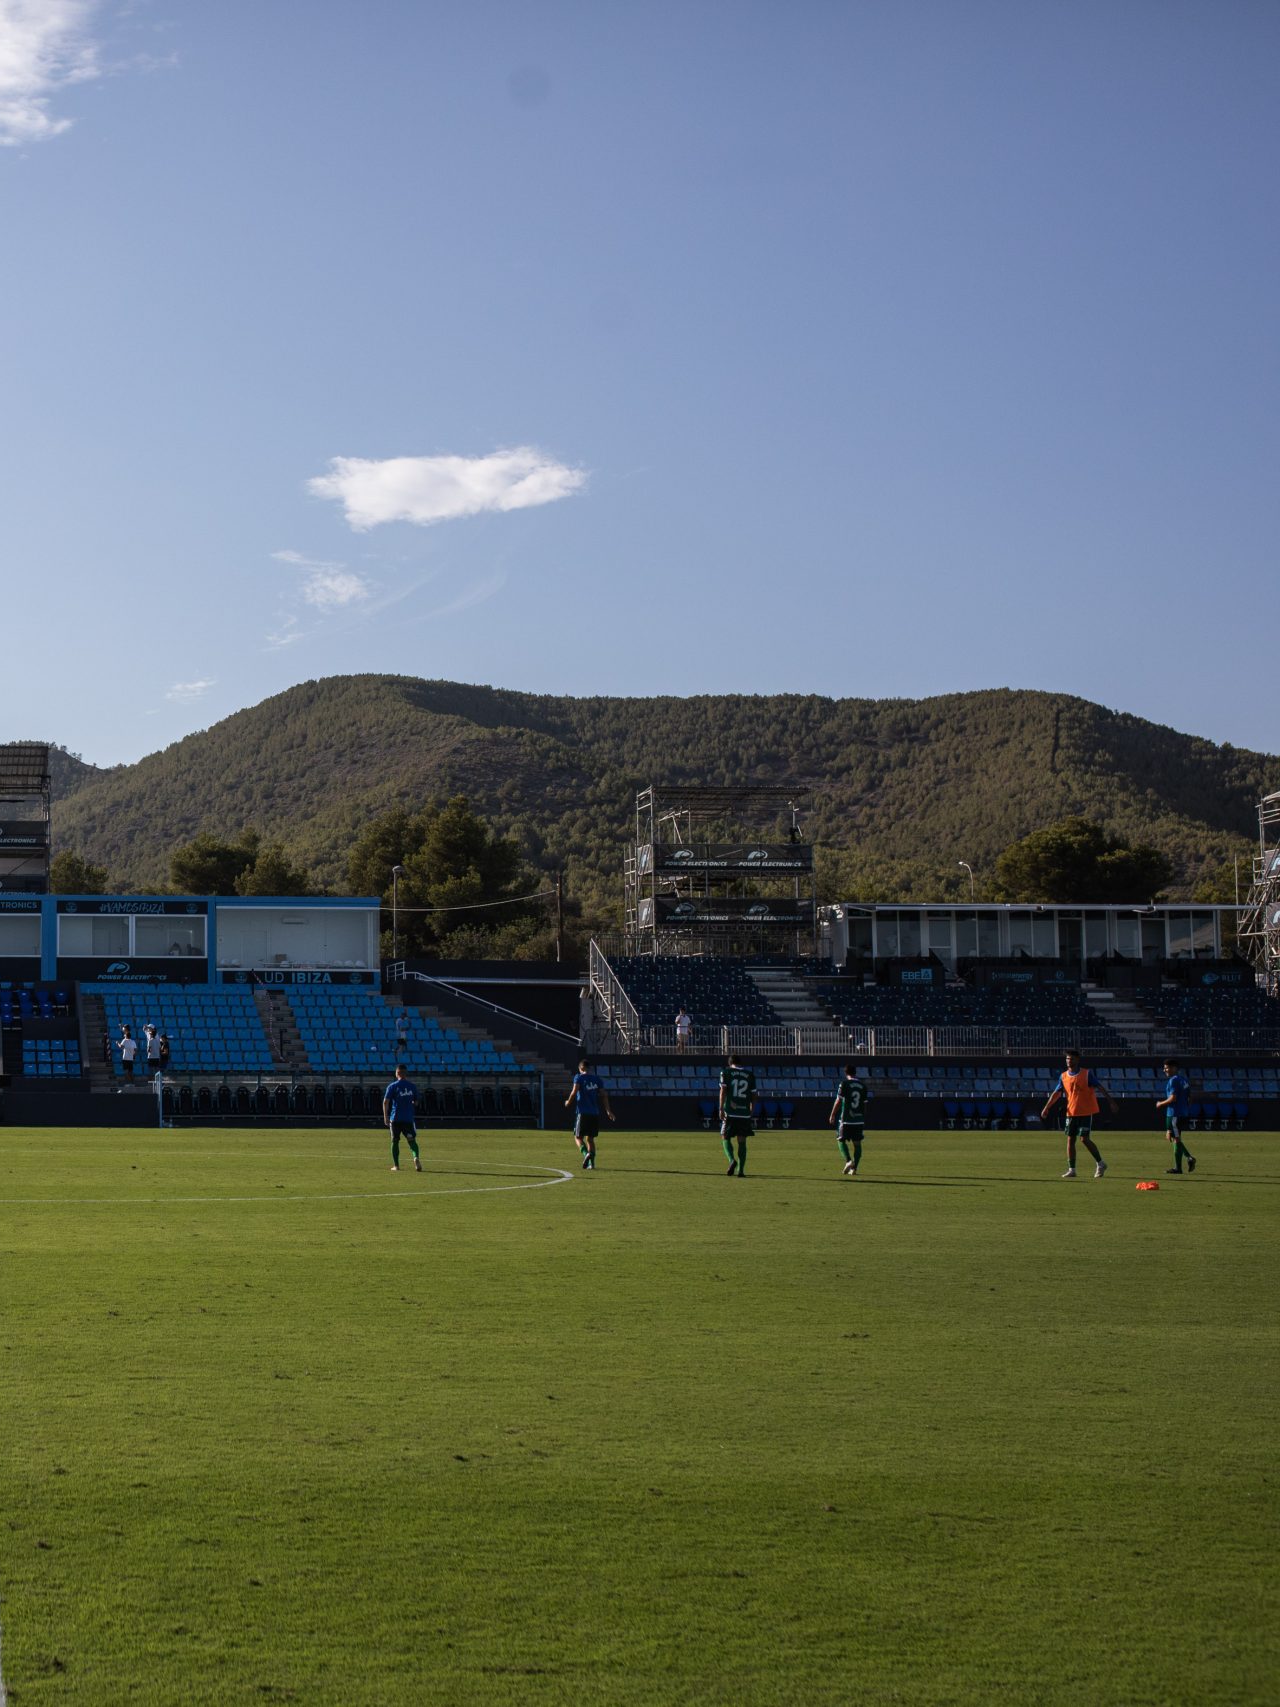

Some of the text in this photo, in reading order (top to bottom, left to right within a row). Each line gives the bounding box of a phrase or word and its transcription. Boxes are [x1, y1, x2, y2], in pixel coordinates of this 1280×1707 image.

[264, 972, 333, 984] UD IBIZA
[731, 1079, 749, 1098] 12
[851, 1090, 861, 1109] 3
